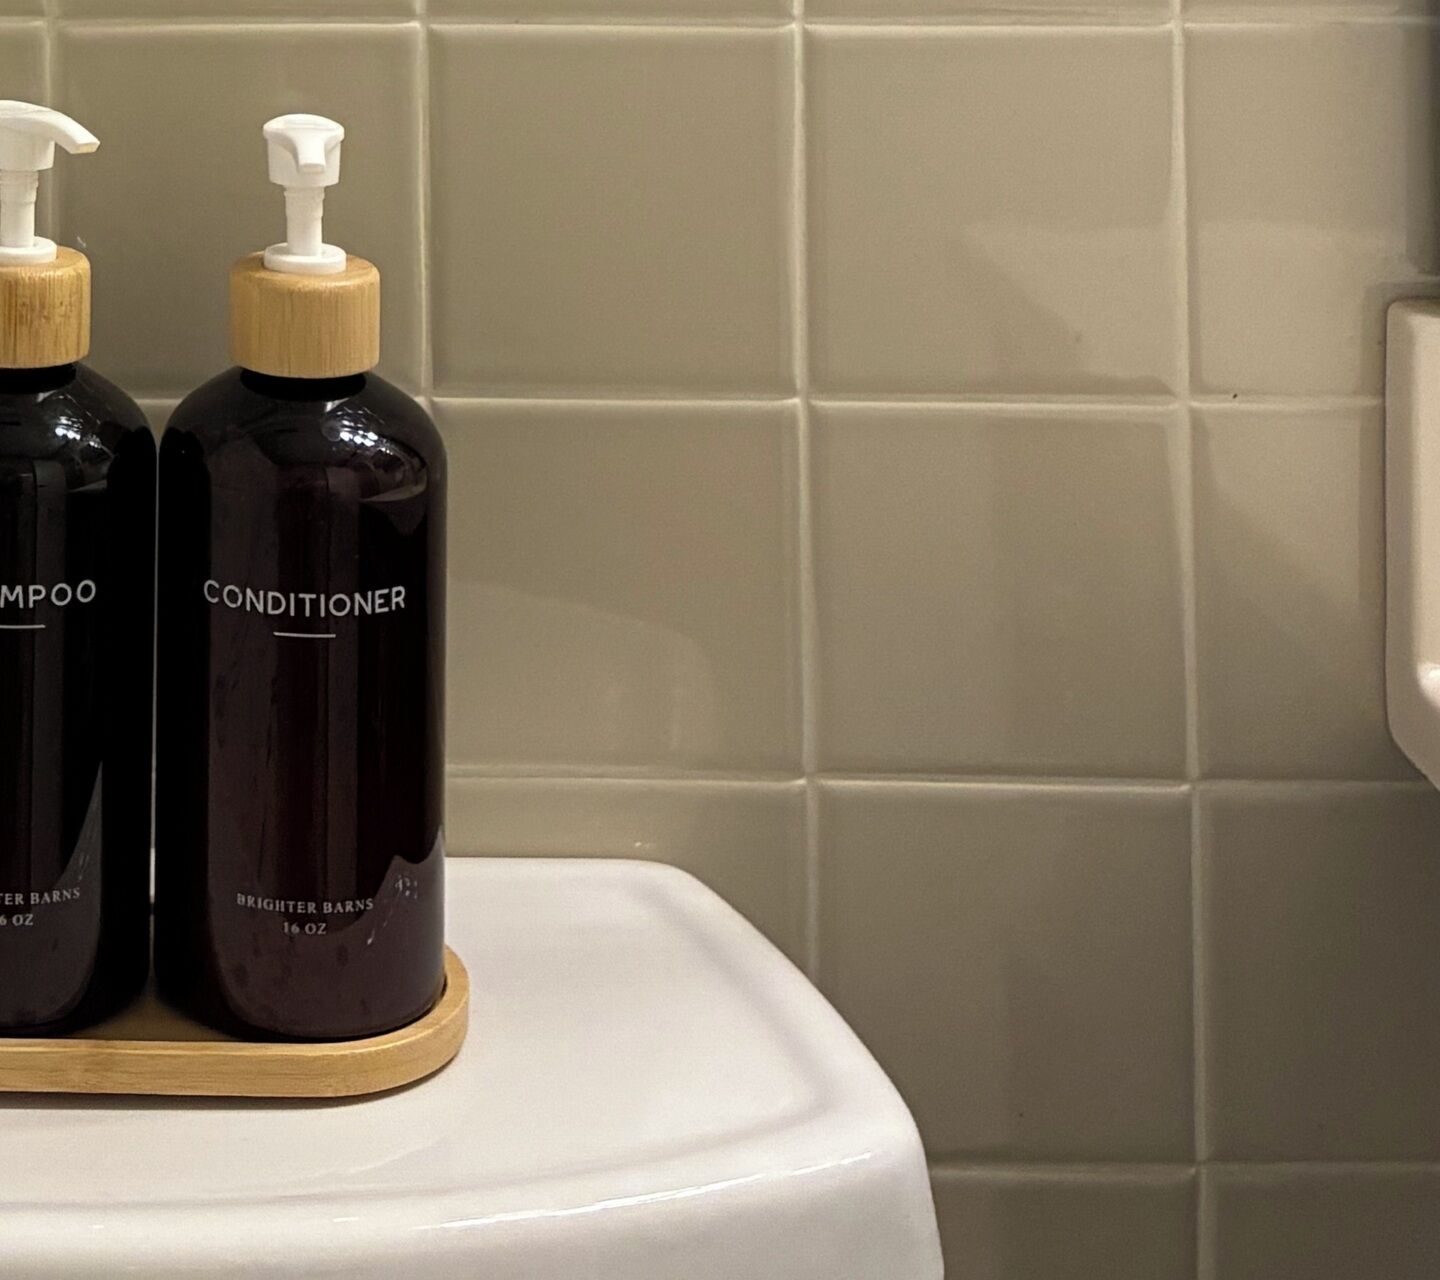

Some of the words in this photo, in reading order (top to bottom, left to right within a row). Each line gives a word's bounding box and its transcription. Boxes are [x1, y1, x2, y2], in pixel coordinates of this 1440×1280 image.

[203, 579, 406, 617] CONDITIONER
[30, 887, 81, 905] BARNS
[236, 893, 316, 913] BRIGHTER
[322, 898, 374, 913] BARNS
[12, 914, 34, 926] OZ
[283, 922, 300, 934] 16
[305, 922, 327, 935] OZ
